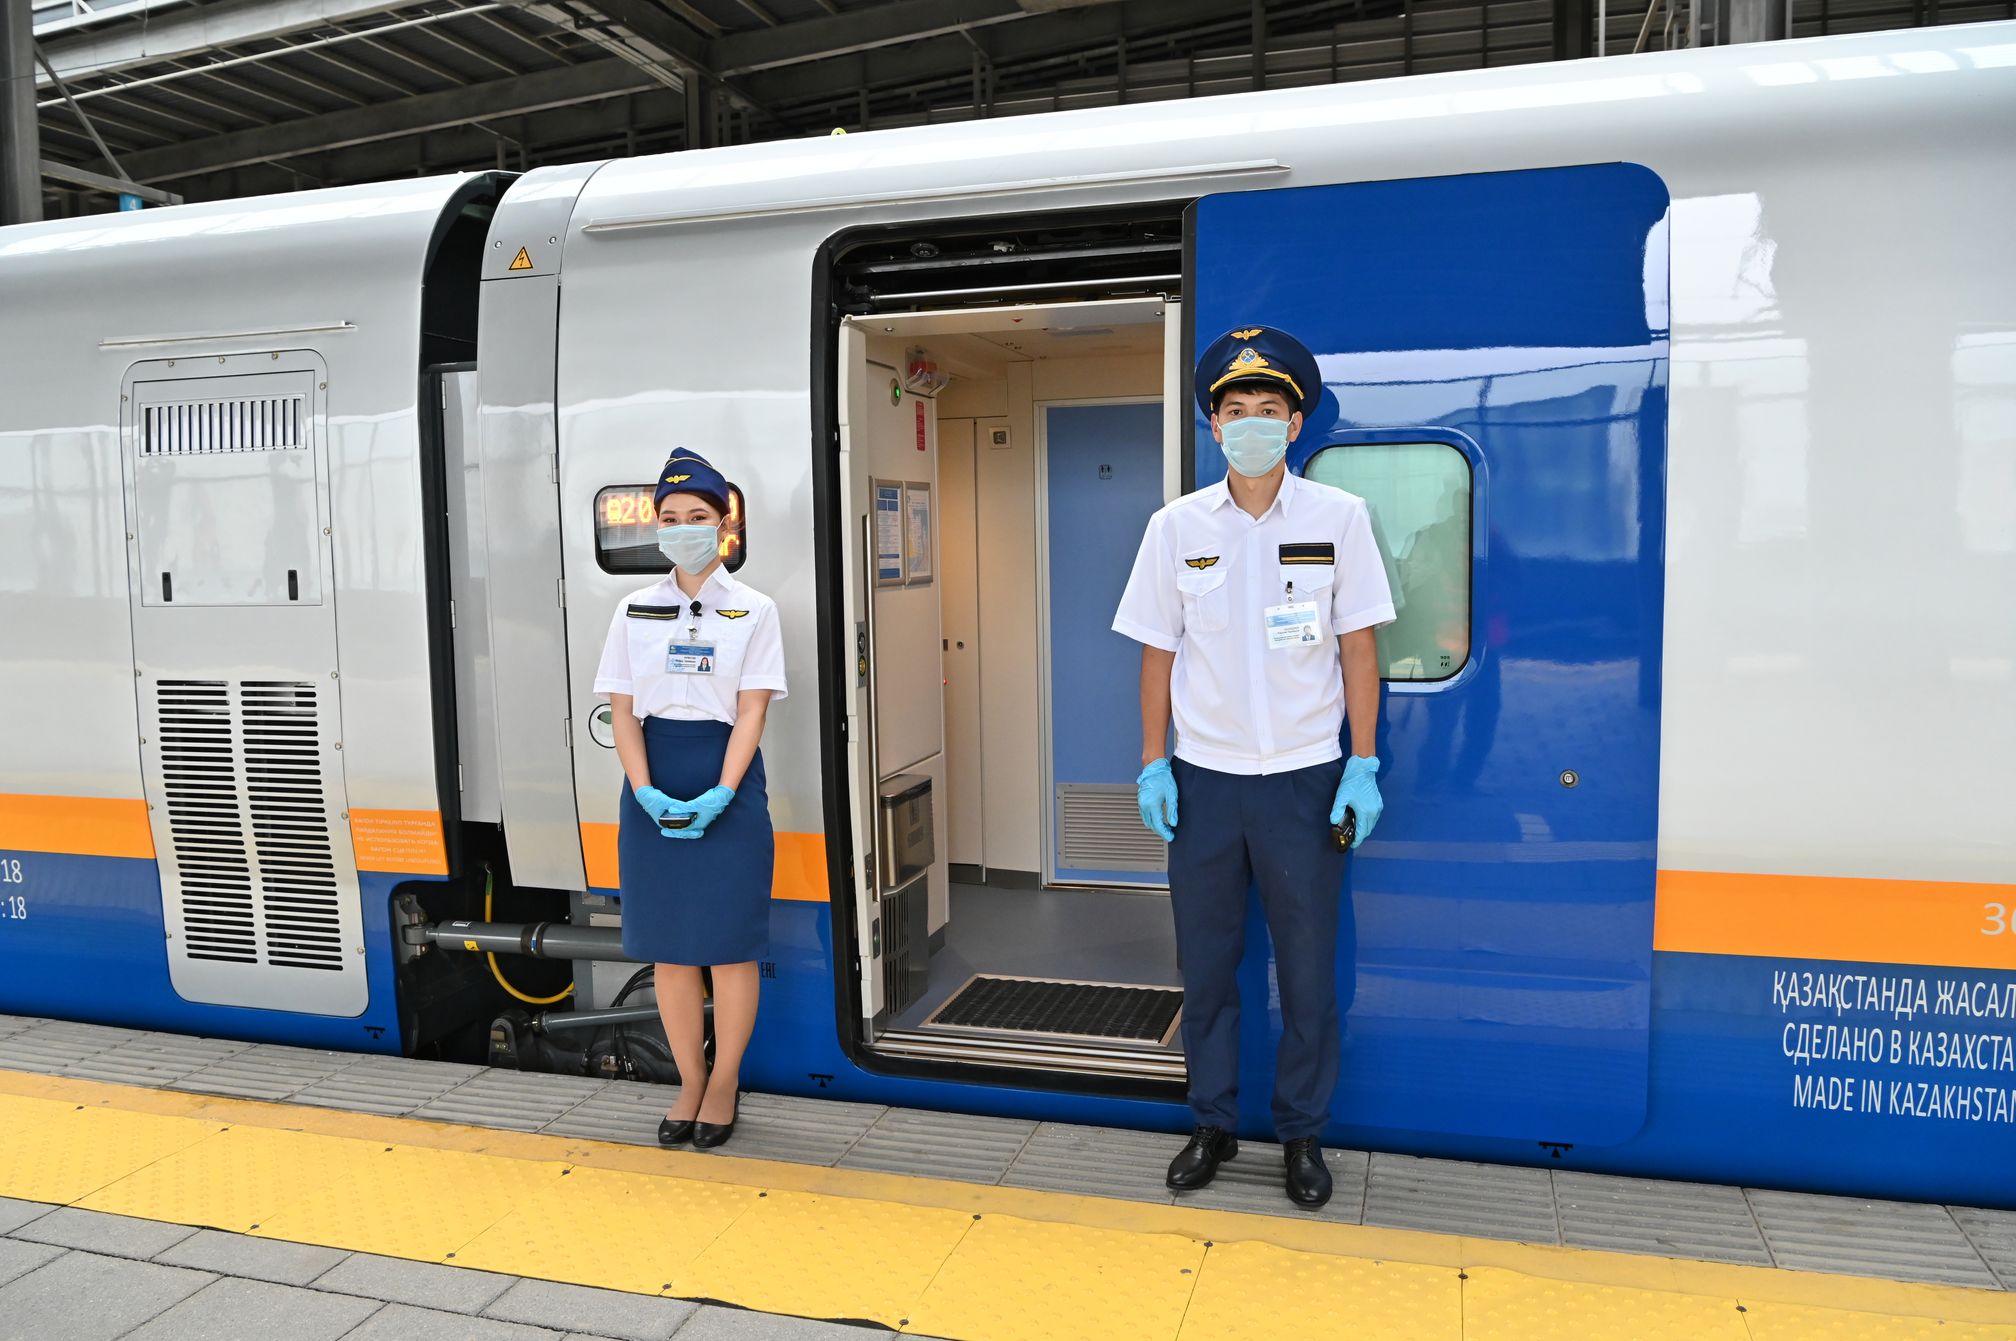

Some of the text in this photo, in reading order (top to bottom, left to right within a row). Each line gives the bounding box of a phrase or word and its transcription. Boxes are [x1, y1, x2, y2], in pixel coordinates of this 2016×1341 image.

[1773, 970, 2016, 1021] ҚАЗАҚСТАНДА ЖАСАЛ
[1782, 1022, 2014, 1072] СДЕЛАНО В КАЗАХСТА
[1793, 1074, 1855, 1111] MADE
[1861, 1079, 1883, 1114] IN
